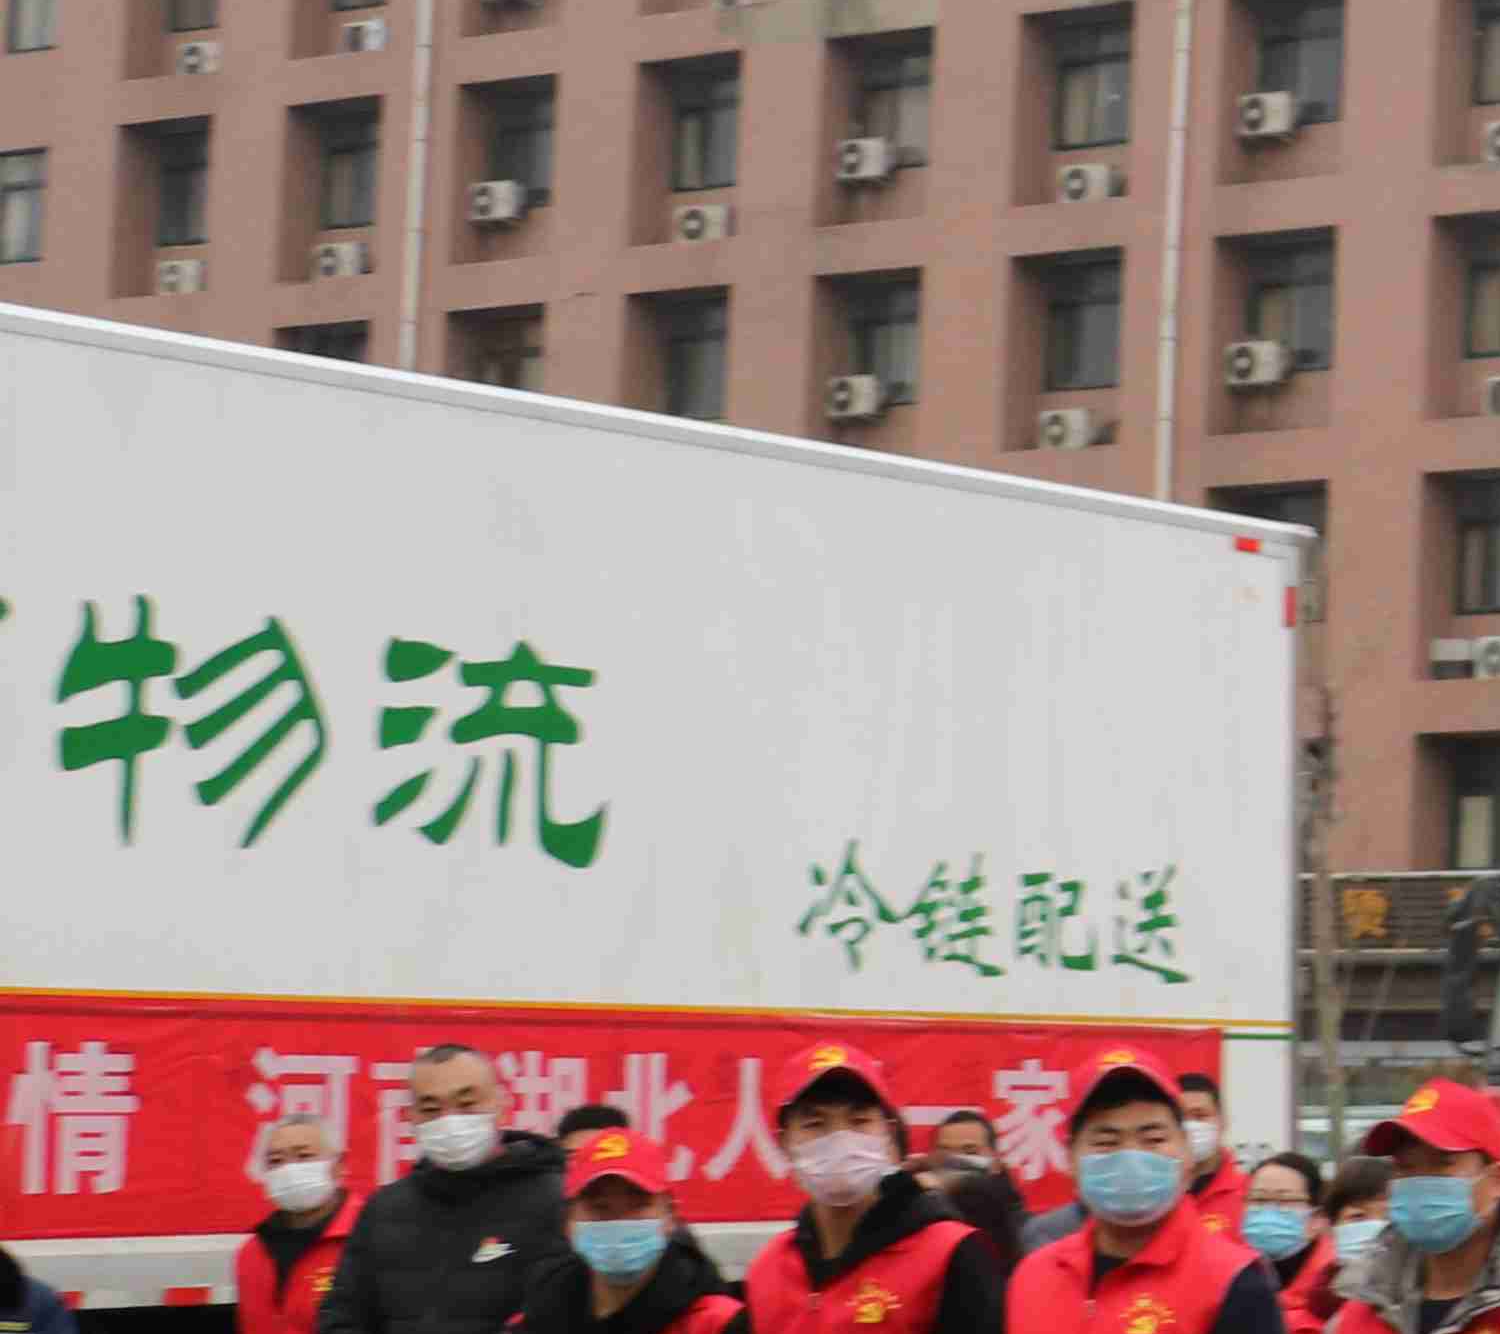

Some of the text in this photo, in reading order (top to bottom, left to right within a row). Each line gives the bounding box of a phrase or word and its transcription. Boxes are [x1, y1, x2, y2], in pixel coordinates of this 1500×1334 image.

[800, 840, 1190, 985] 冷链配送
[6, 1041, 140, 1195] 情
